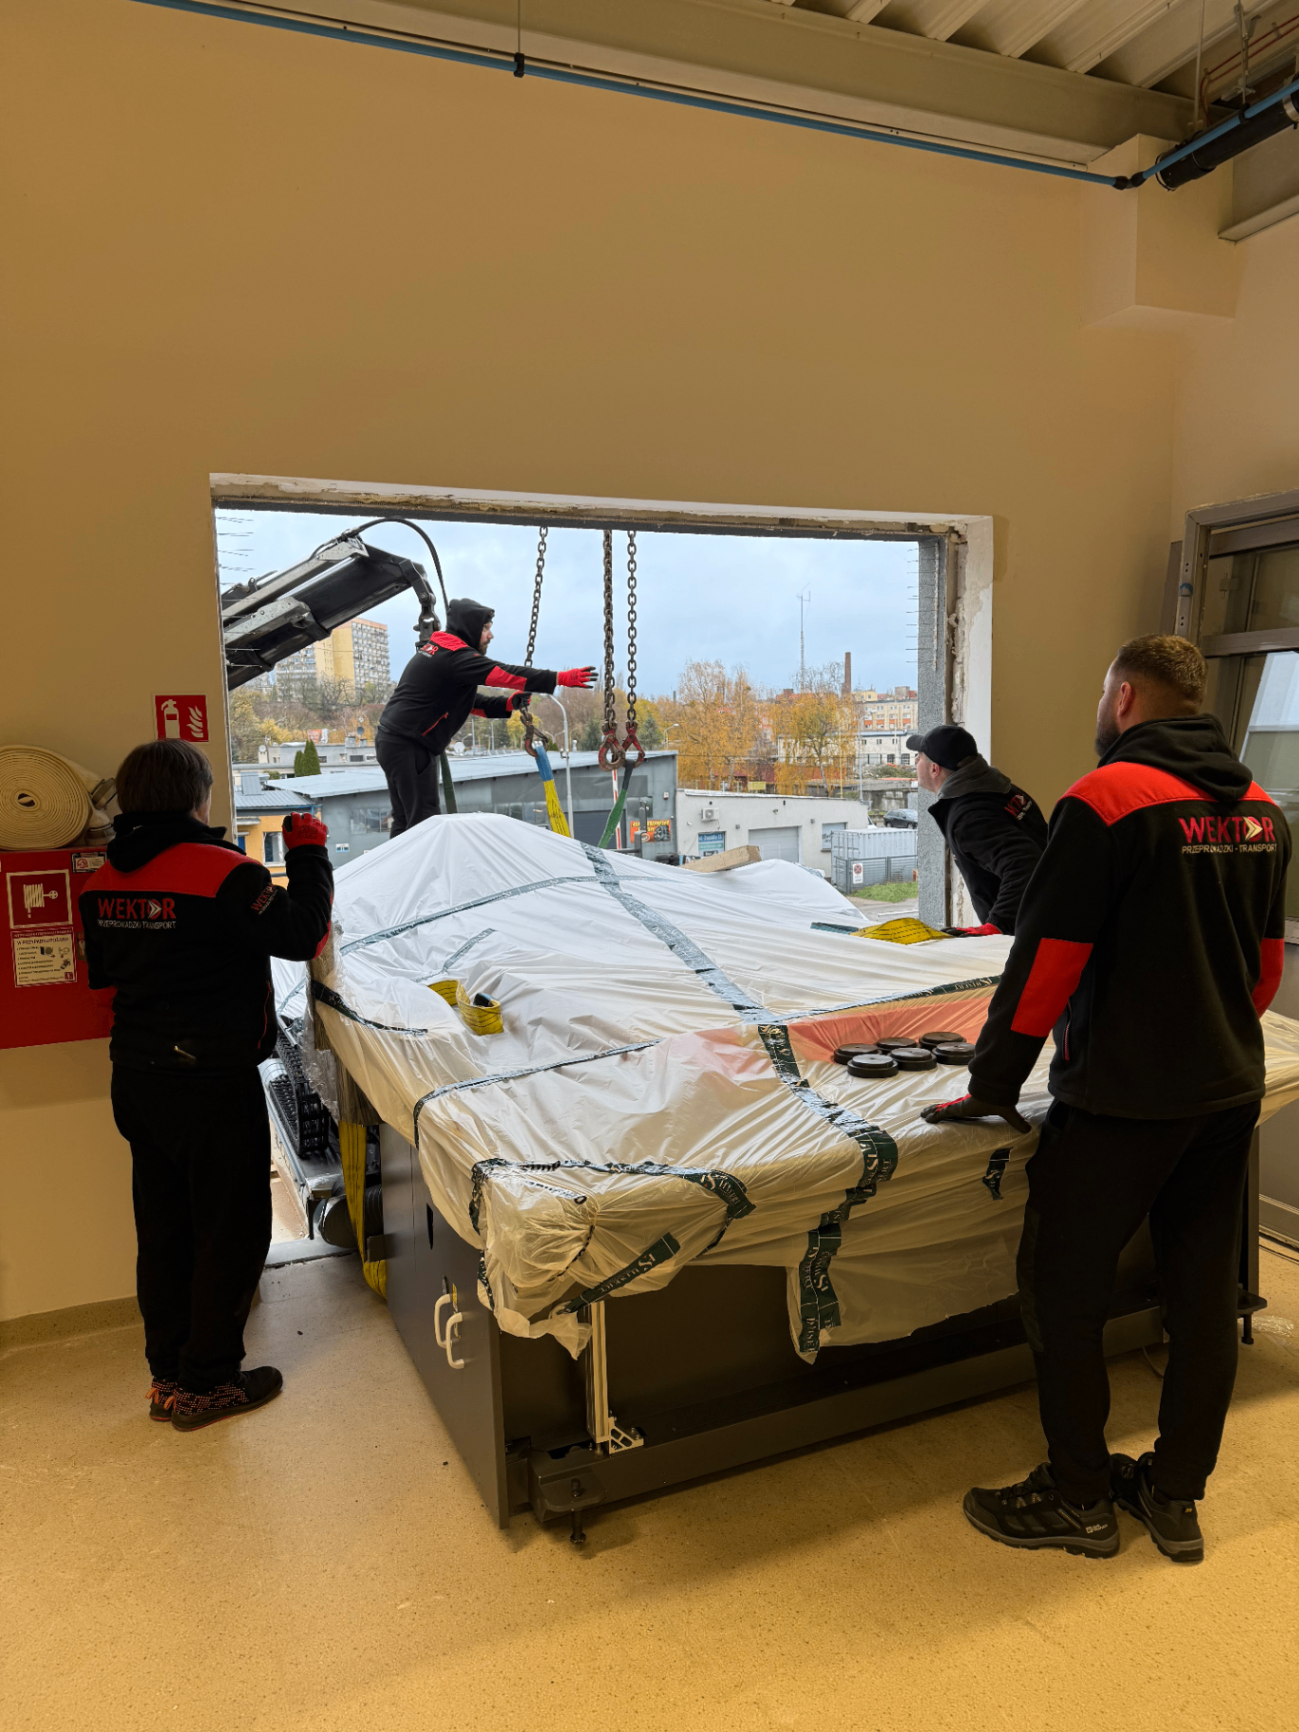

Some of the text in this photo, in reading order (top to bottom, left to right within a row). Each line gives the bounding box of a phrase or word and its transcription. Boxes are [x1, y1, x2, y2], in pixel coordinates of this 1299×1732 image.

[1178, 816, 1275, 843] WEKTOR
[1239, 843, 1277, 852] TRANSPORT
[97, 897, 177, 920] WEKTOR
[141, 919, 177, 930] TRANSPORT
